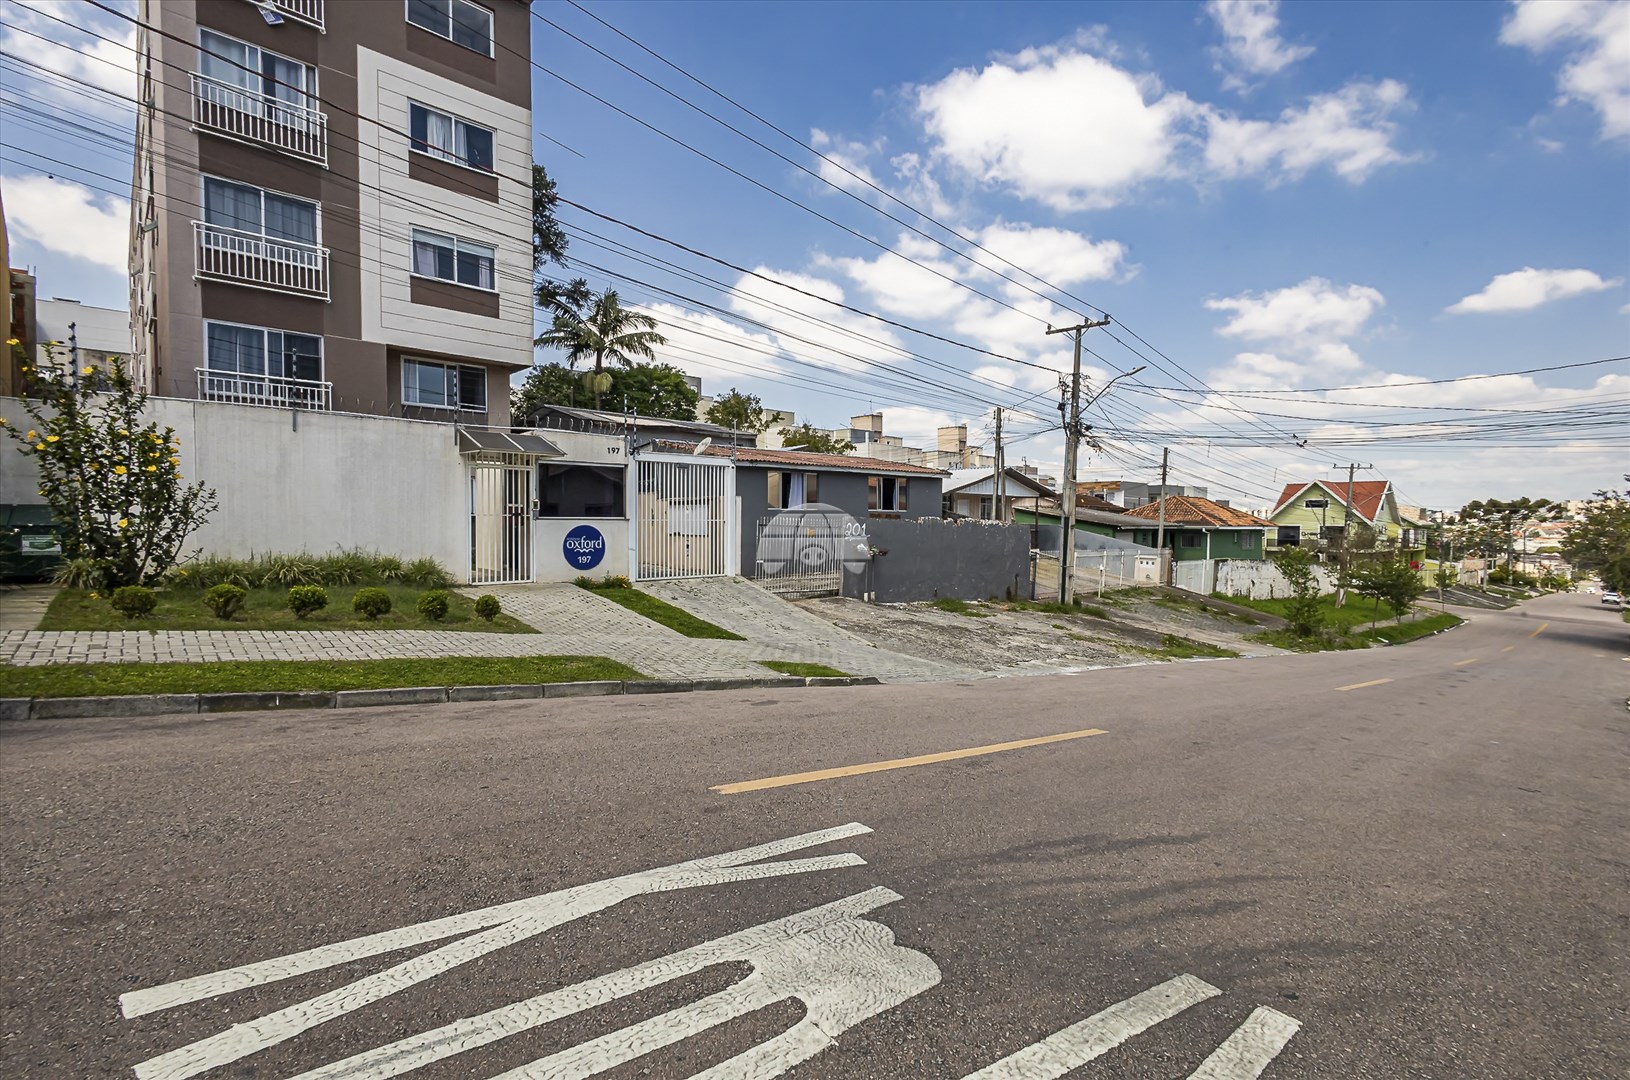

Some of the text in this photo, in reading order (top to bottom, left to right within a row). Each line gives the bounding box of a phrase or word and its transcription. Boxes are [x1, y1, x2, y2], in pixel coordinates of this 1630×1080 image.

[607, 447, 620, 455] 197
[845, 522, 867, 536] 201
[566, 535, 602, 549] oxford
[577, 555, 592, 564] 197
